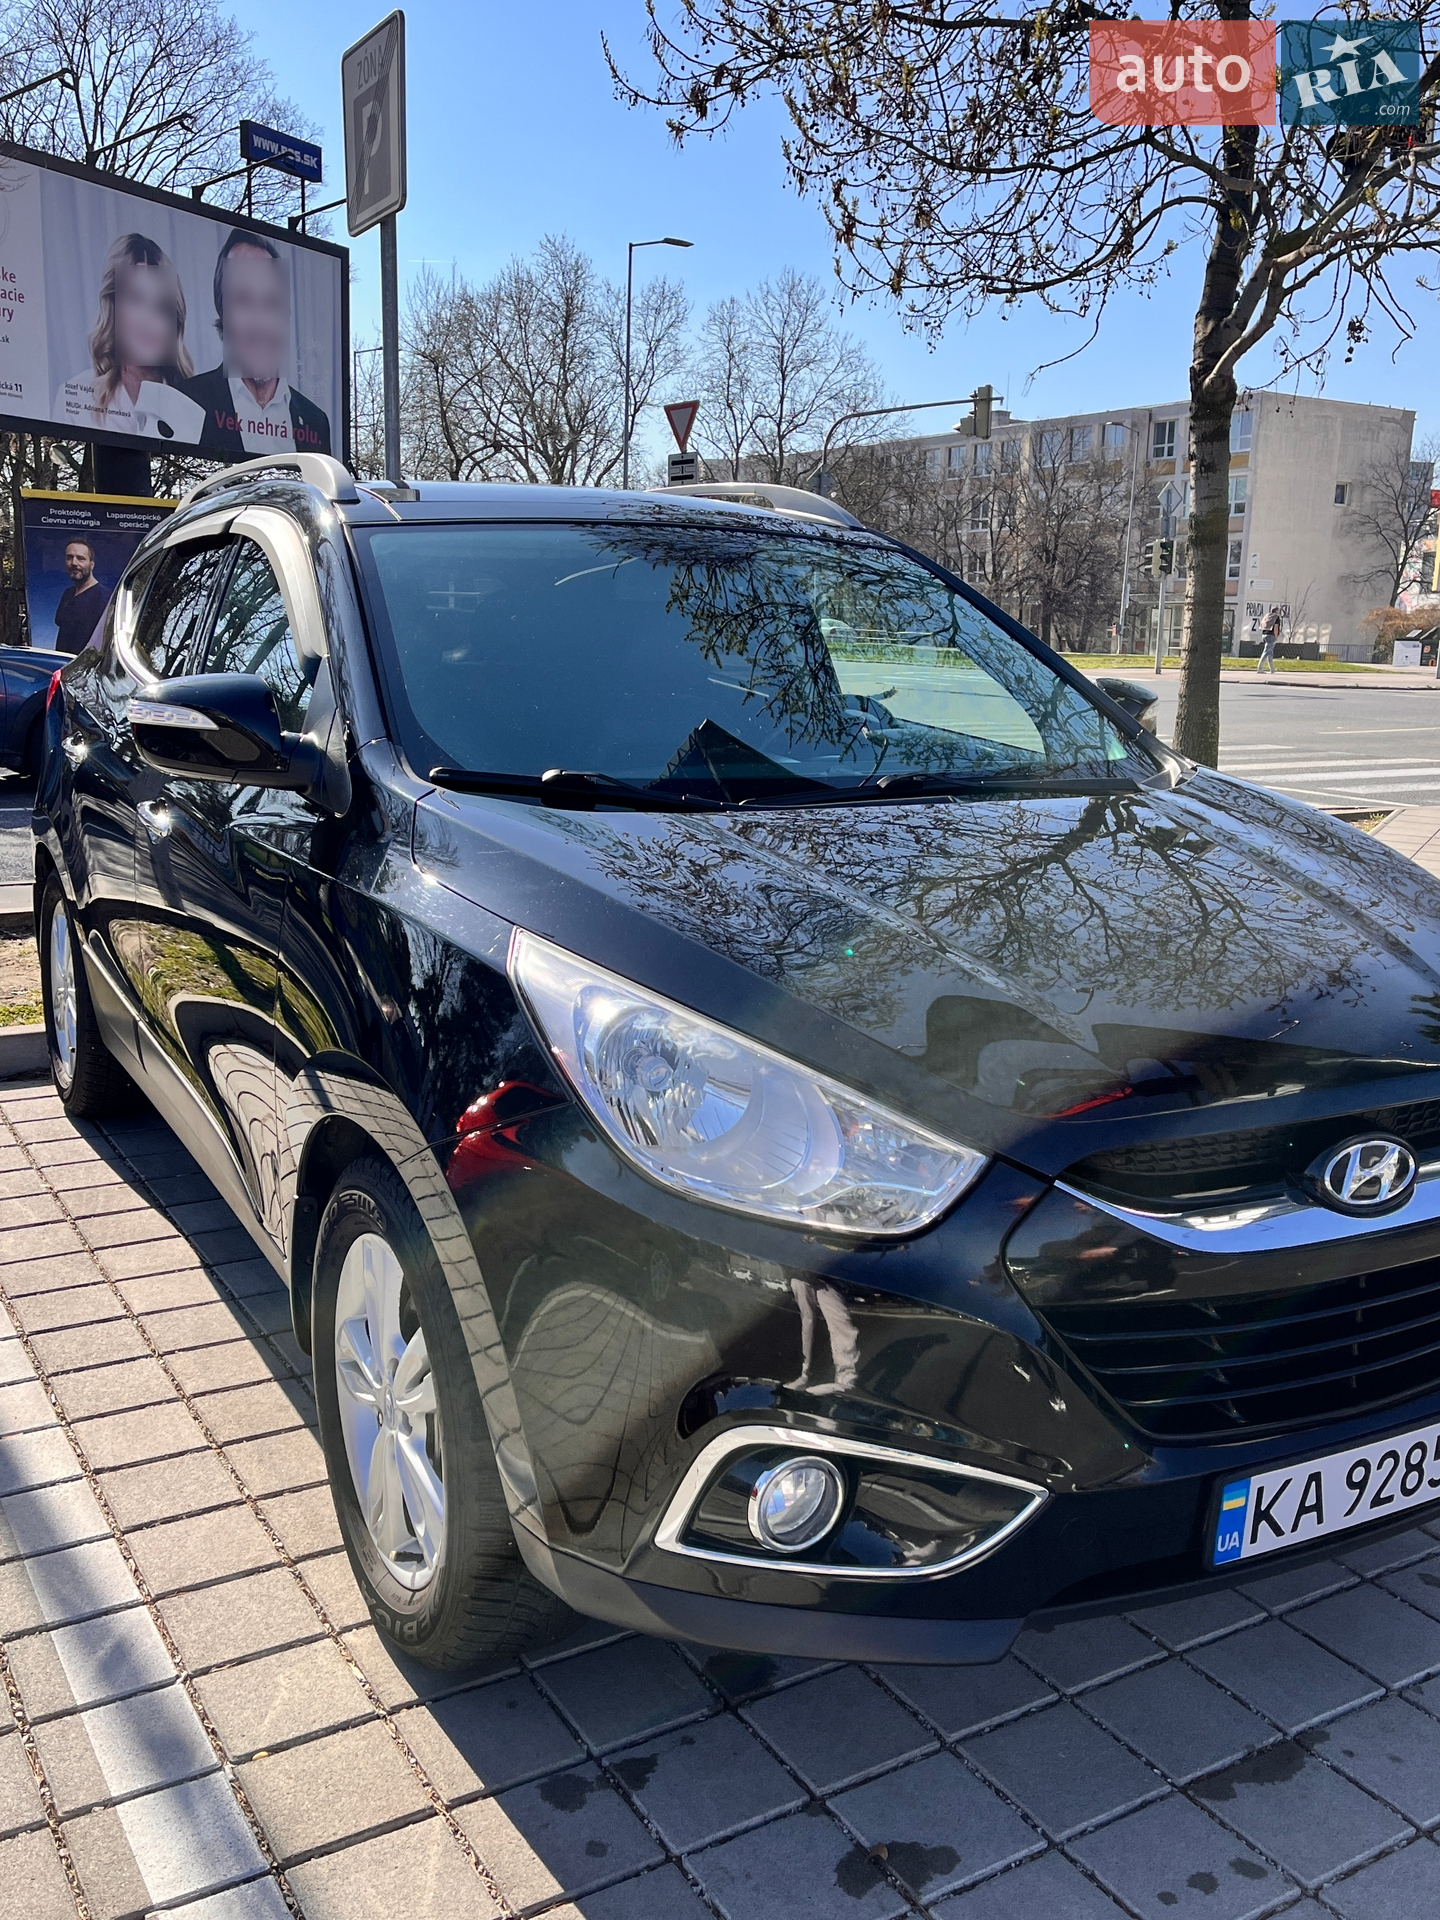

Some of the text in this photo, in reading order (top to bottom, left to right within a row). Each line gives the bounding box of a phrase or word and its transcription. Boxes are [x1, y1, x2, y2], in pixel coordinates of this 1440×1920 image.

[0, 266, 16, 283] ke
[0, 288, 25, 303] acie
[0, 307, 14, 323] ry
[14, 383, 22, 392] 11
[65, 382, 94, 394] Jozef Vajda
[214, 410, 322, 445] Vek nehrá rolu.
[49, 508, 92, 518] Proktológia
[106, 511, 161, 521] Laparoskopické
[41, 516, 101, 527] Cievna chirurgia
[119, 521, 150, 529] operácie
[1250, 1470, 1324, 1545] KA
[1217, 1531, 1240, 1552] UA
